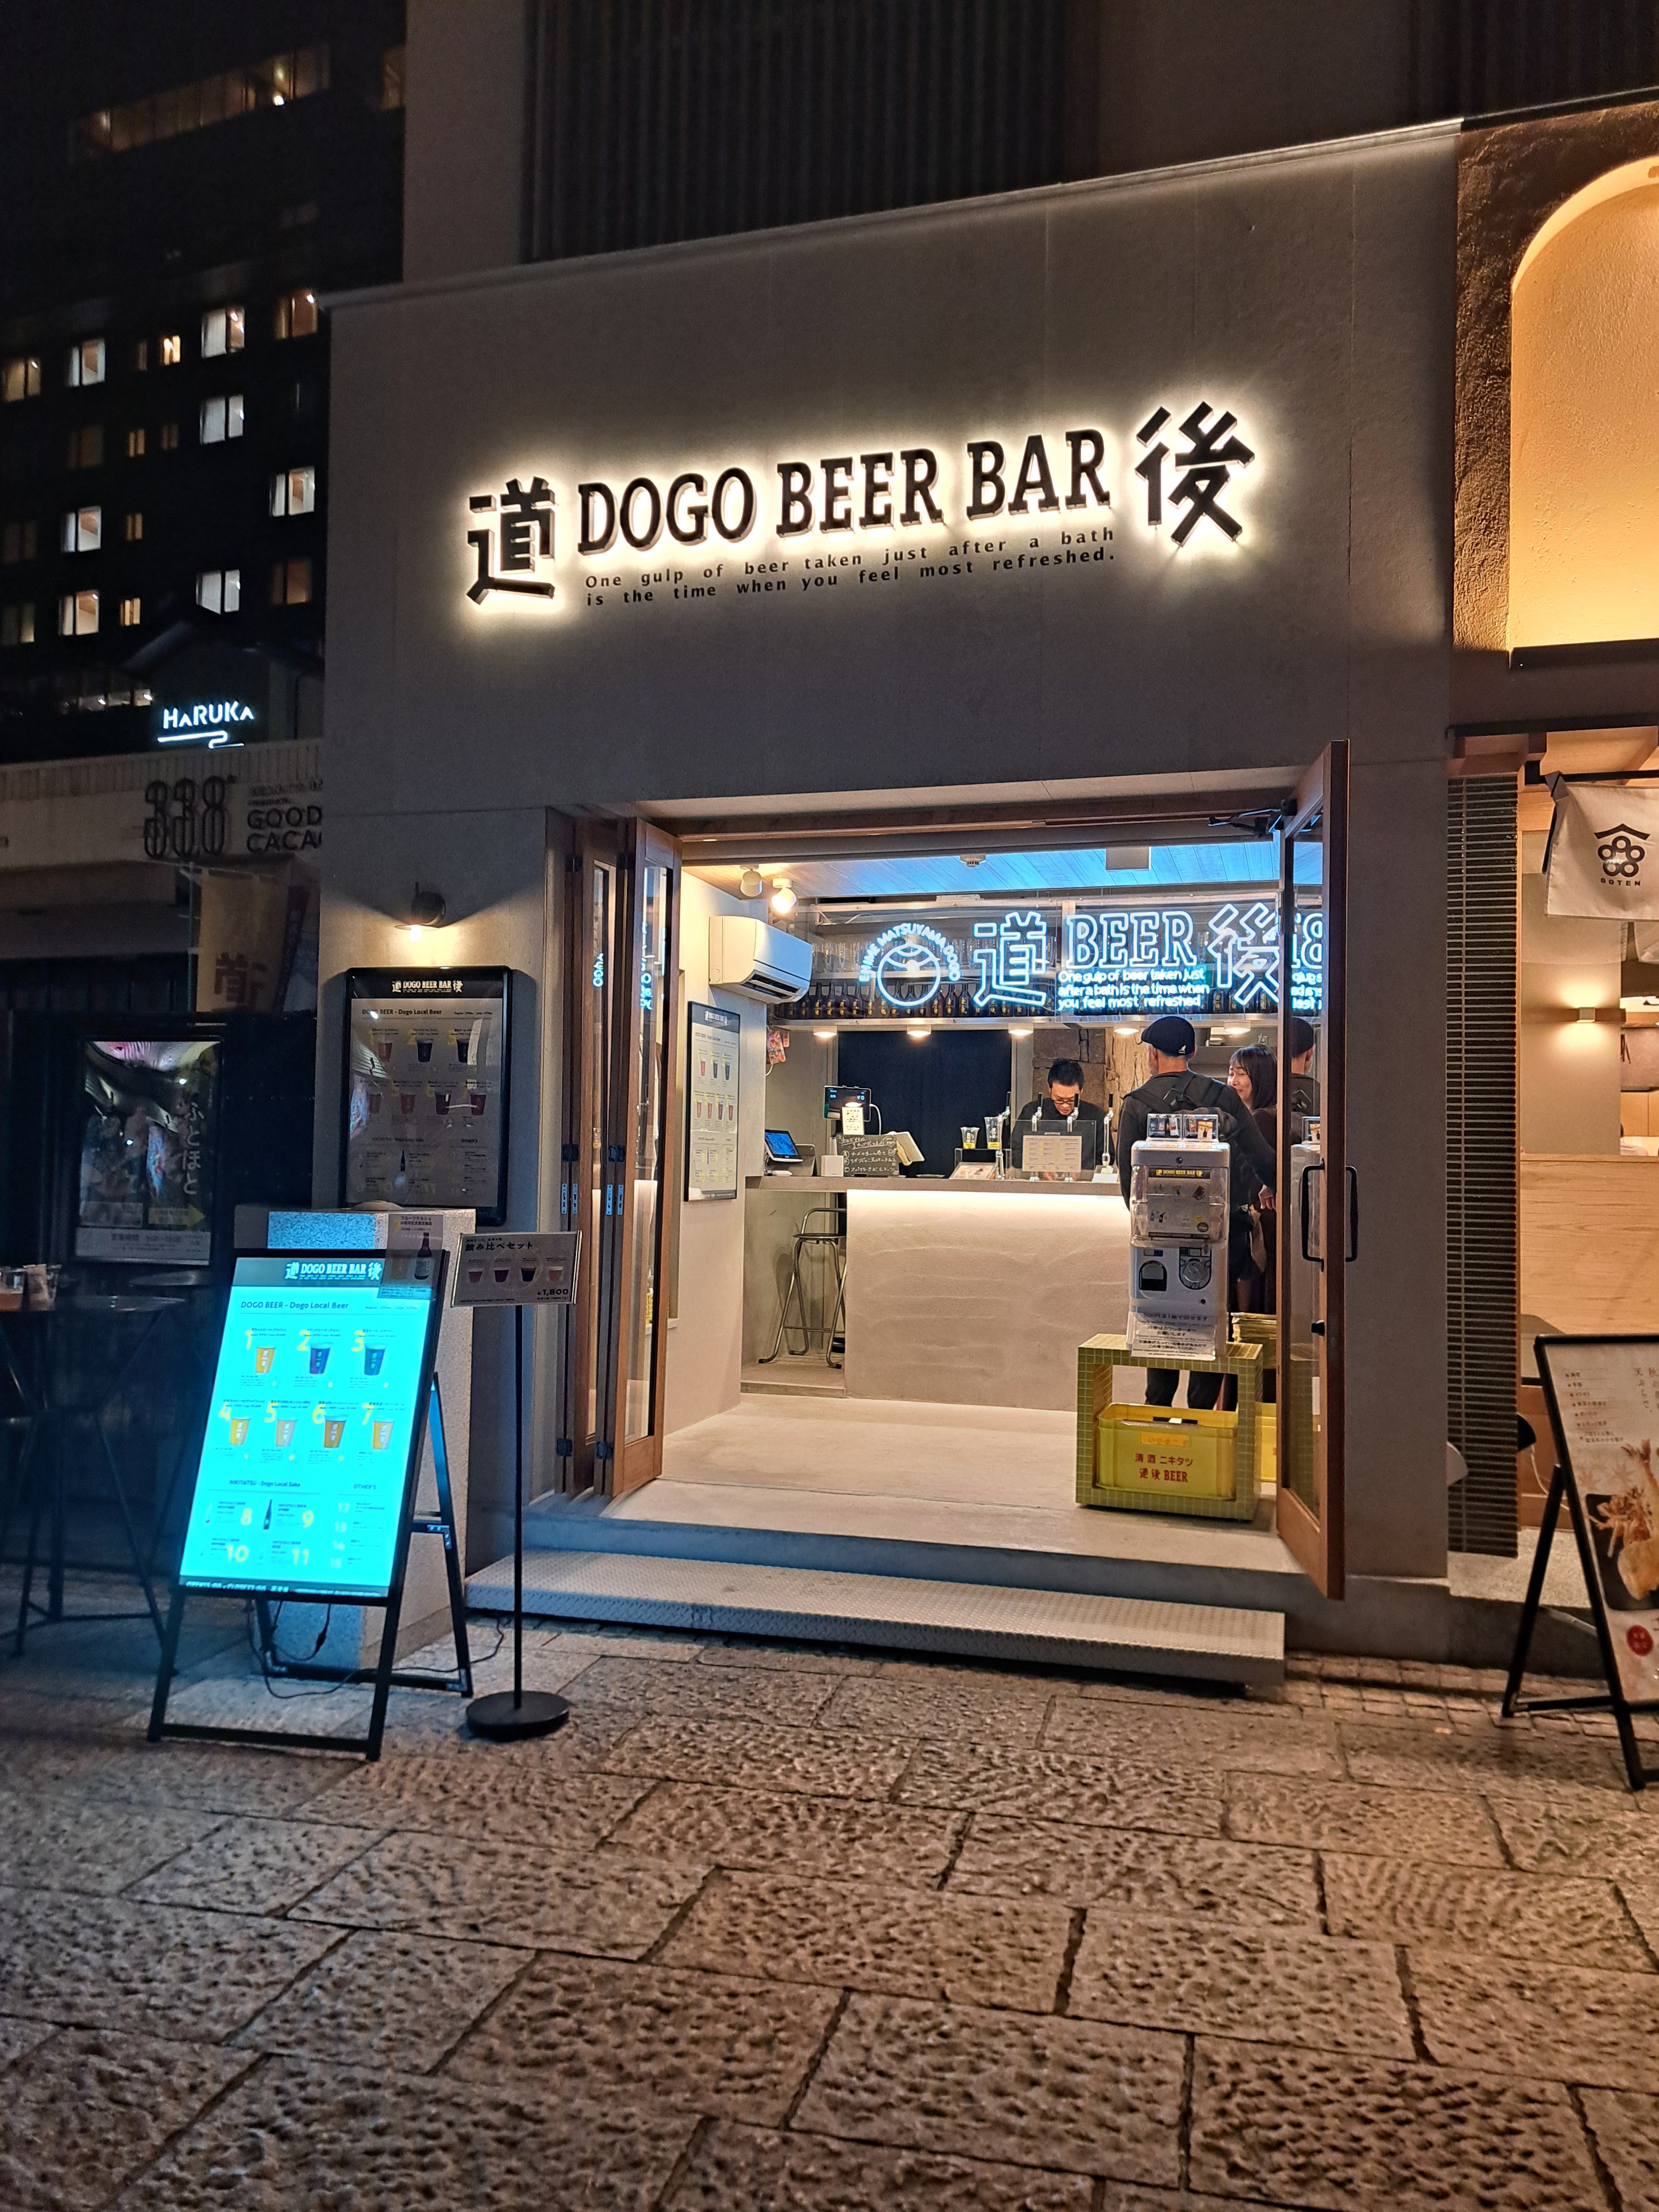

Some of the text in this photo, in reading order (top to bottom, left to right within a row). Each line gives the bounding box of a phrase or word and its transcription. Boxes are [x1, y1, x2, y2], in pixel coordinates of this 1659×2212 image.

[466, 401, 1255, 605] 道 DOGO BEER BAR 後
[586, 527, 1113, 587] One gulp of beer taken just after a bath
[587, 547, 1115, 606] is the time when you feel most refreshed.
[247, 805, 322, 830] GOOD
[1600, 877, 1641, 886] GOTEN
[859, 923, 961, 983] EHIME MATSUYAMA DOGO
[973, 911, 1047, 1007] 道
[1066, 911, 1197, 970] BEER
[421, 980, 438, 988] BEER
[439, 980, 451, 988] BAR
[1058, 967, 1206, 984] One gulp of beer taken just
[1130, 982, 1151, 995] the
[1058, 998, 1080, 1012] you
[1082, 995, 1106, 1009] feel
[1108, 996, 1139, 1008] most
[300, 1262, 325, 1274] DOGO
[326, 1262, 347, 1274] BEER
[349, 1262, 366, 1274] BAR
[290, 1302, 309, 1310] Dogo
[245, 1329, 365, 1352] 1 2 3
[265, 1401, 278, 1423] 5
[312, 1401, 326, 1424] 6
[362, 1403, 375, 1426] 7
[1160, 1456, 1193, 1466] ニキタツ
[1163, 1470, 1188, 1482] BEER
[241, 1508, 314, 1528] 8 9
[227, 1545, 310, 1565] 10 11
